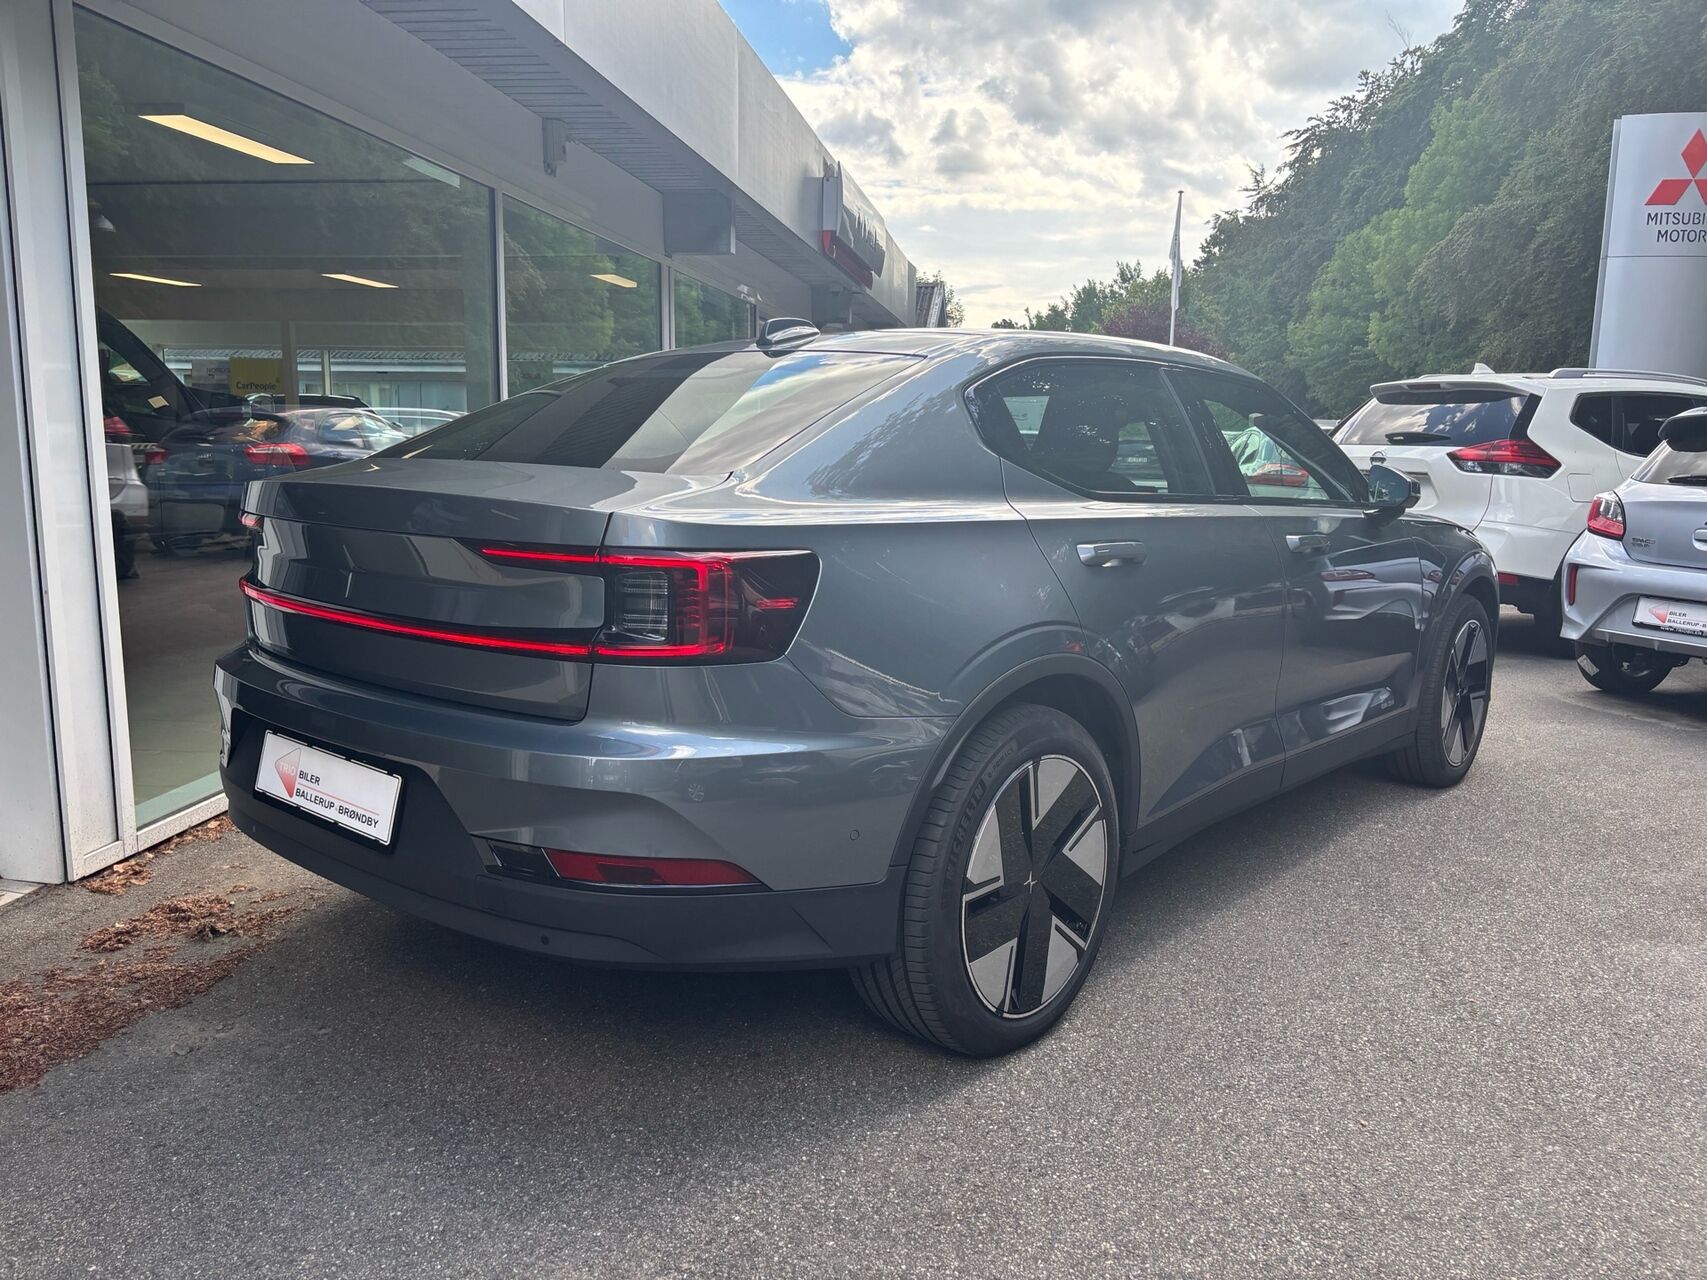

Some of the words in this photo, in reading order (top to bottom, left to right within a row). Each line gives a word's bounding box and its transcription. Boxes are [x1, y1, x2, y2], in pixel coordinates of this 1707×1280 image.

[1646, 212, 1707, 226] MITSUBI
[236, 381, 277, 390] CarPeople
[298, 770, 320, 786] BILER
